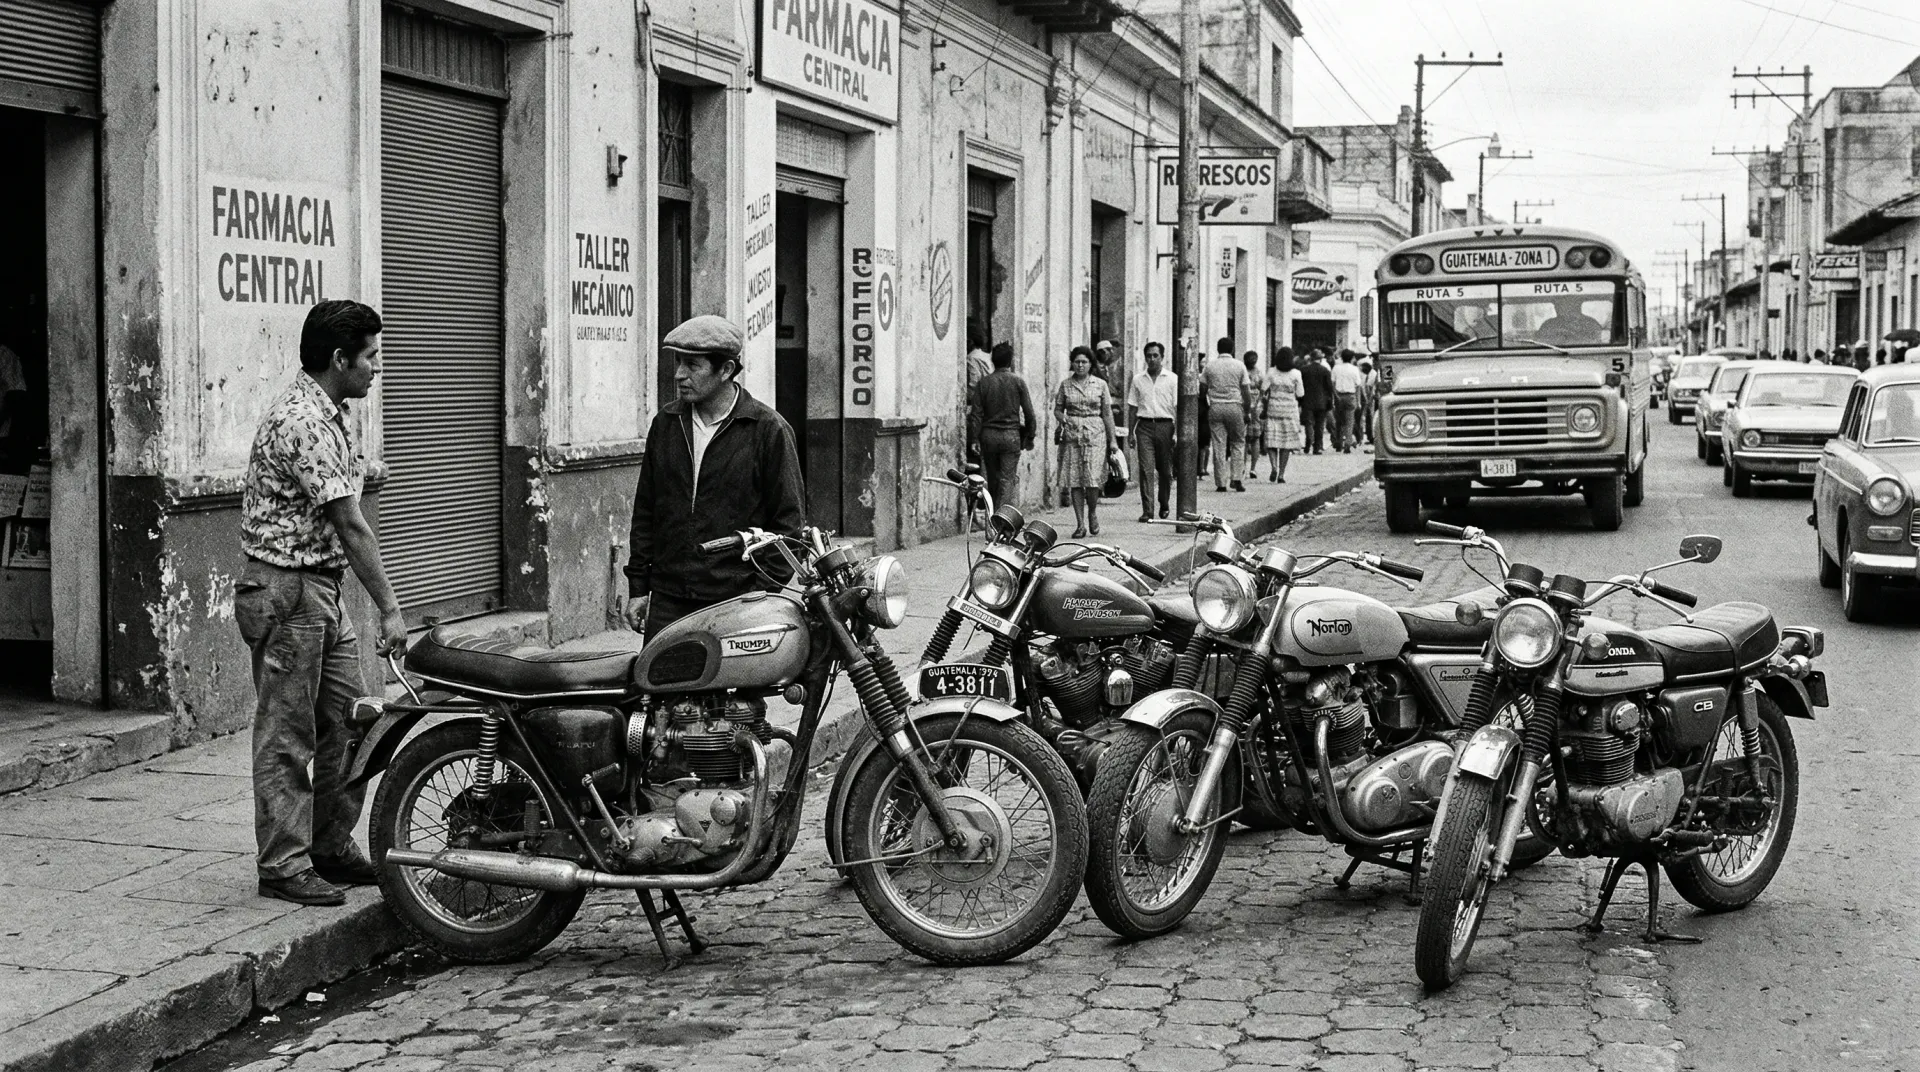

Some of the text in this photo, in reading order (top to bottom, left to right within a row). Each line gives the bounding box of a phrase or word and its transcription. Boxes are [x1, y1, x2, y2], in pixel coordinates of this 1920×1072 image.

[803, 53, 868, 102] CENTRAL
[1164, 164, 1271, 185] RRESCOS
[213, 186, 335, 247] FARMACIA
[576, 233, 629, 272] TALLER
[1446, 252, 1507, 268] GUATEMALA
[1515, 251, 1543, 265] ZONA
[218, 252, 329, 305] CENTRAL
[572, 274, 634, 317] MECÁNICO
[1416, 288, 1464, 298] RUTA 5
[1534, 282, 1583, 294] RUTA 5
[1612, 358, 1624, 372] 5
[1062, 598, 1113, 609] HARLEY
[1073, 609, 1122, 620] DAVIDSON
[1306, 618, 1352, 637] Norton
[727, 639, 771, 652] TRIUMPH
[1608, 647, 1636, 656] ONDA
[929, 667, 977, 677] GUATEMALA
[937, 676, 995, 696] 4-3811
[1694, 701, 1713, 711] CB
